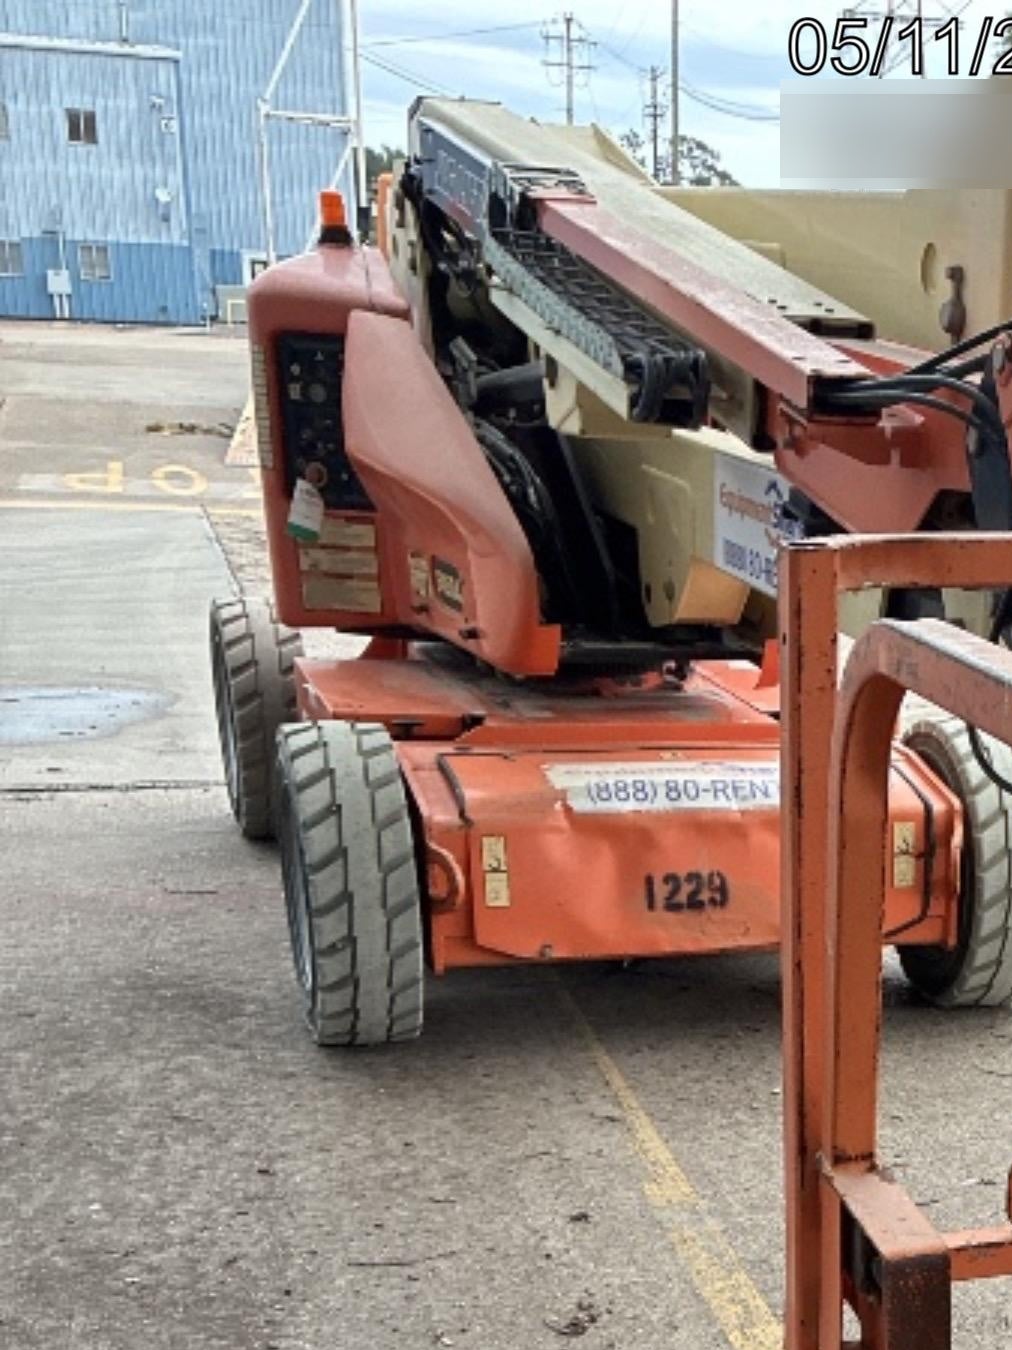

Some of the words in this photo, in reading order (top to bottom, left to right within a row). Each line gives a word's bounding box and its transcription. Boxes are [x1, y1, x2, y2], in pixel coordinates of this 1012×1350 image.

[587, 779, 657, 804] (888)
[665, 779, 780, 802] 80-REN
[644, 868, 730, 912] 1229
